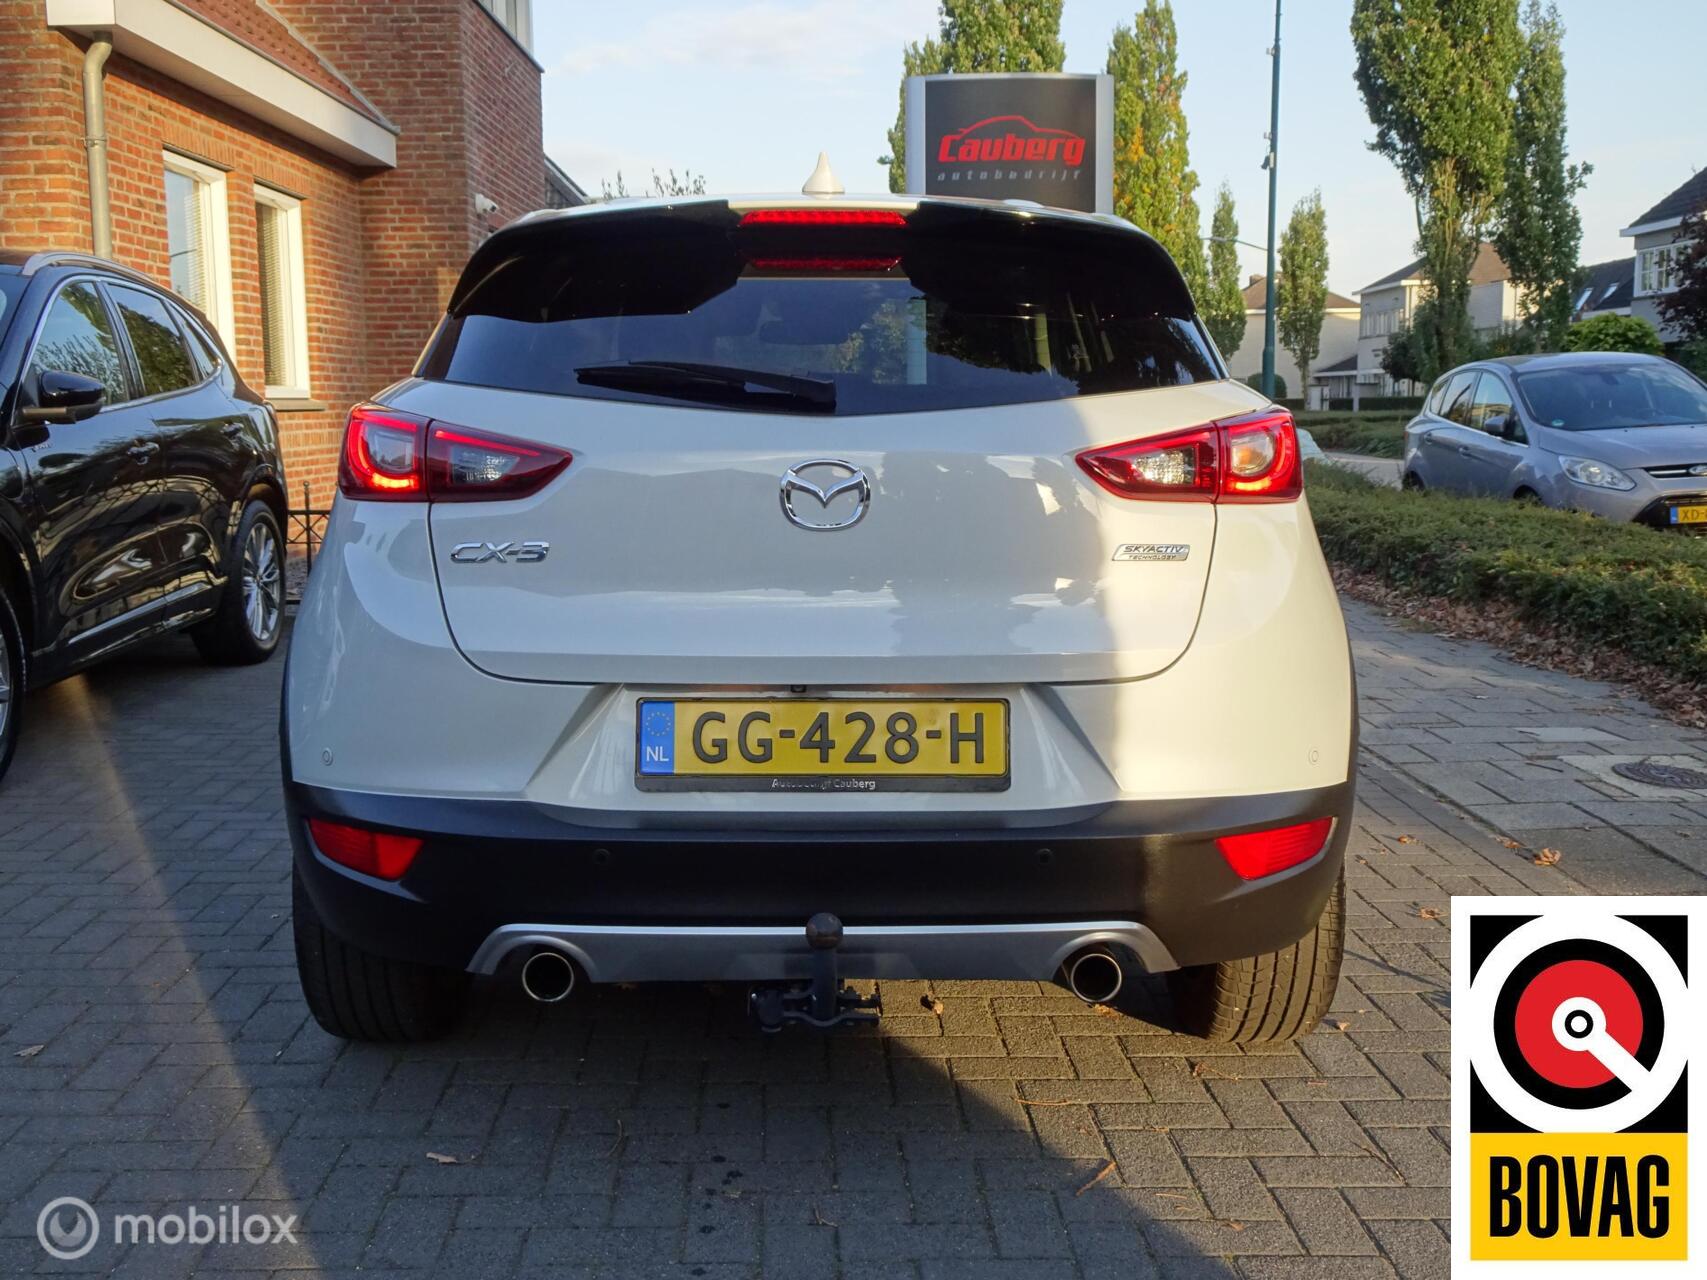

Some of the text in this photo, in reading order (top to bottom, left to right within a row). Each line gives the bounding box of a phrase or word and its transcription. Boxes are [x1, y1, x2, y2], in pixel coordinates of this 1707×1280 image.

[938, 133, 1085, 167] Cauberg
[1681, 509, 1707, 521] XD-
[451, 541, 550, 563] CX-3
[1123, 545, 1184, 553] SKYACTIV
[692, 711, 985, 764] GG-428-H
[646, 746, 669, 761] NL
